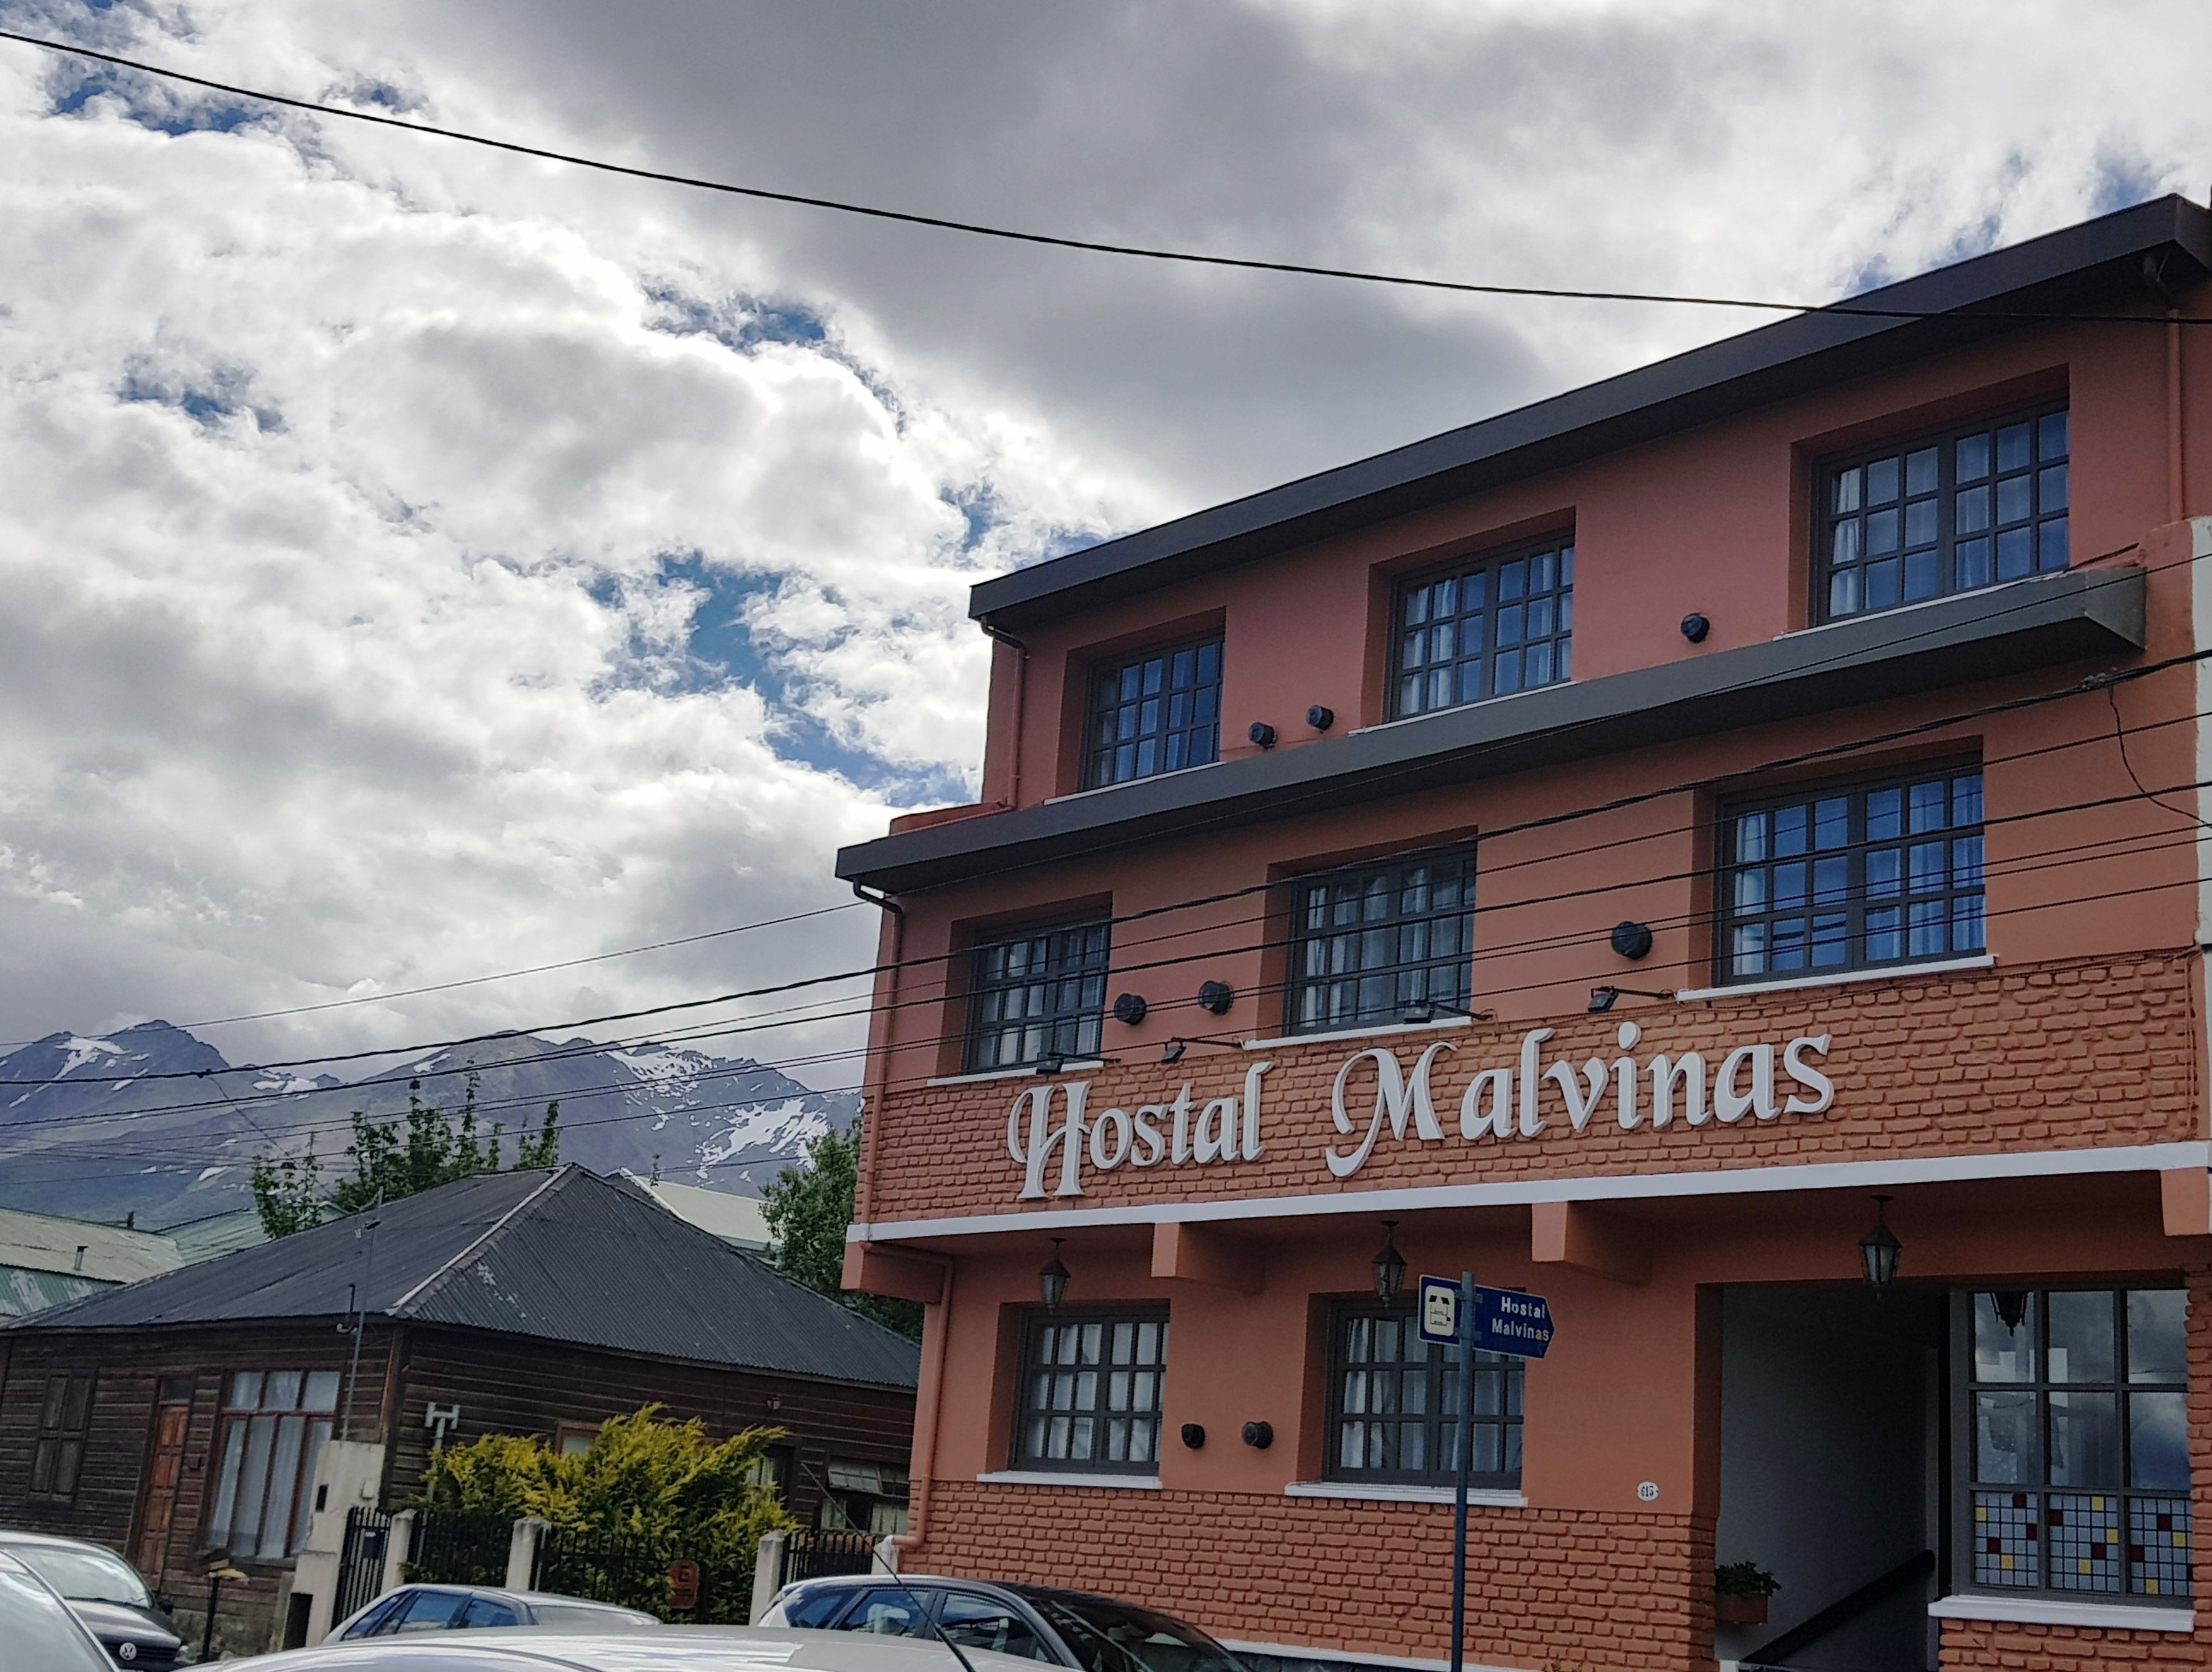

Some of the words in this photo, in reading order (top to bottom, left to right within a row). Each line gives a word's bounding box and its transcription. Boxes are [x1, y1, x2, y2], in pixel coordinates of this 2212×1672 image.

[1007, 1061, 1275, 1198] Hostal
[1326, 1020, 1835, 1177] Malvinas
[1500, 1296, 1545, 1319] Hostal
[1492, 1318, 1549, 1341] Malvinas
[1641, 1485, 1654, 1496] 615
